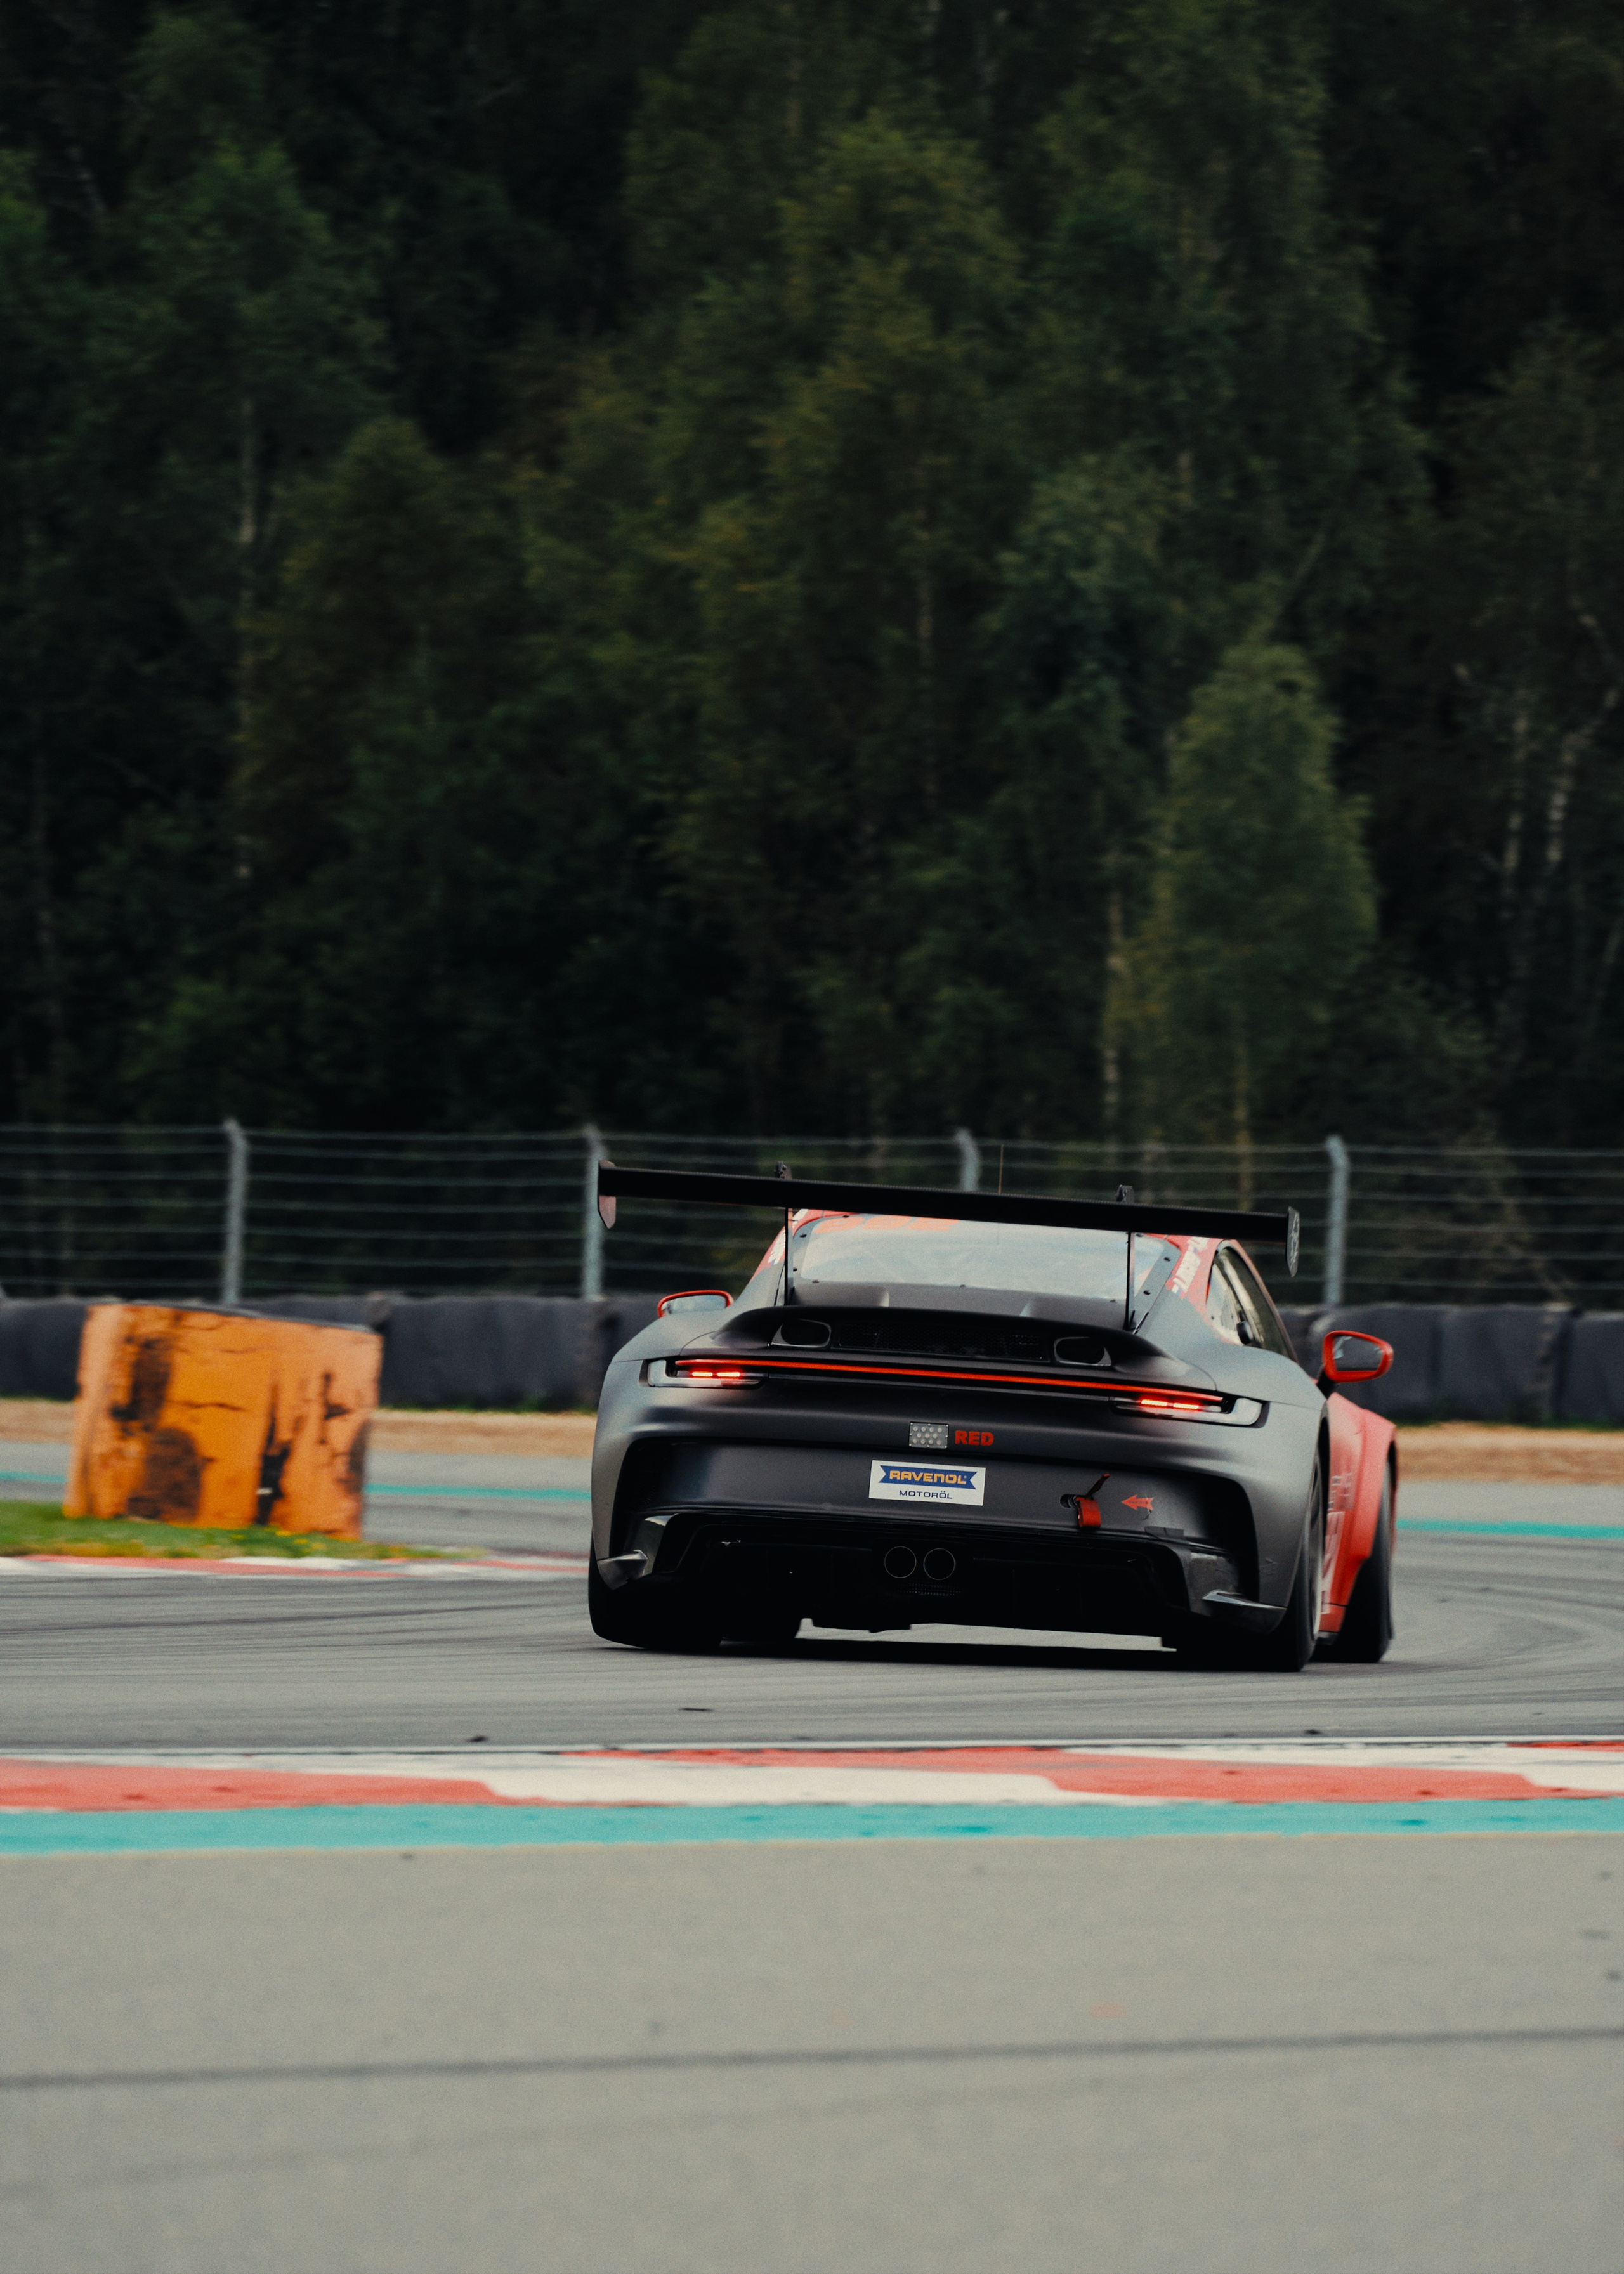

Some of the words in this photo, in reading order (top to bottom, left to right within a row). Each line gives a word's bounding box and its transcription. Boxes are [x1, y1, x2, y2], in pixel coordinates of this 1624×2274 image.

[955, 1430, 994, 1446] RED
[889, 1470, 967, 1485] RAVENOL
[899, 1490, 953, 1500] MOTORÖL
